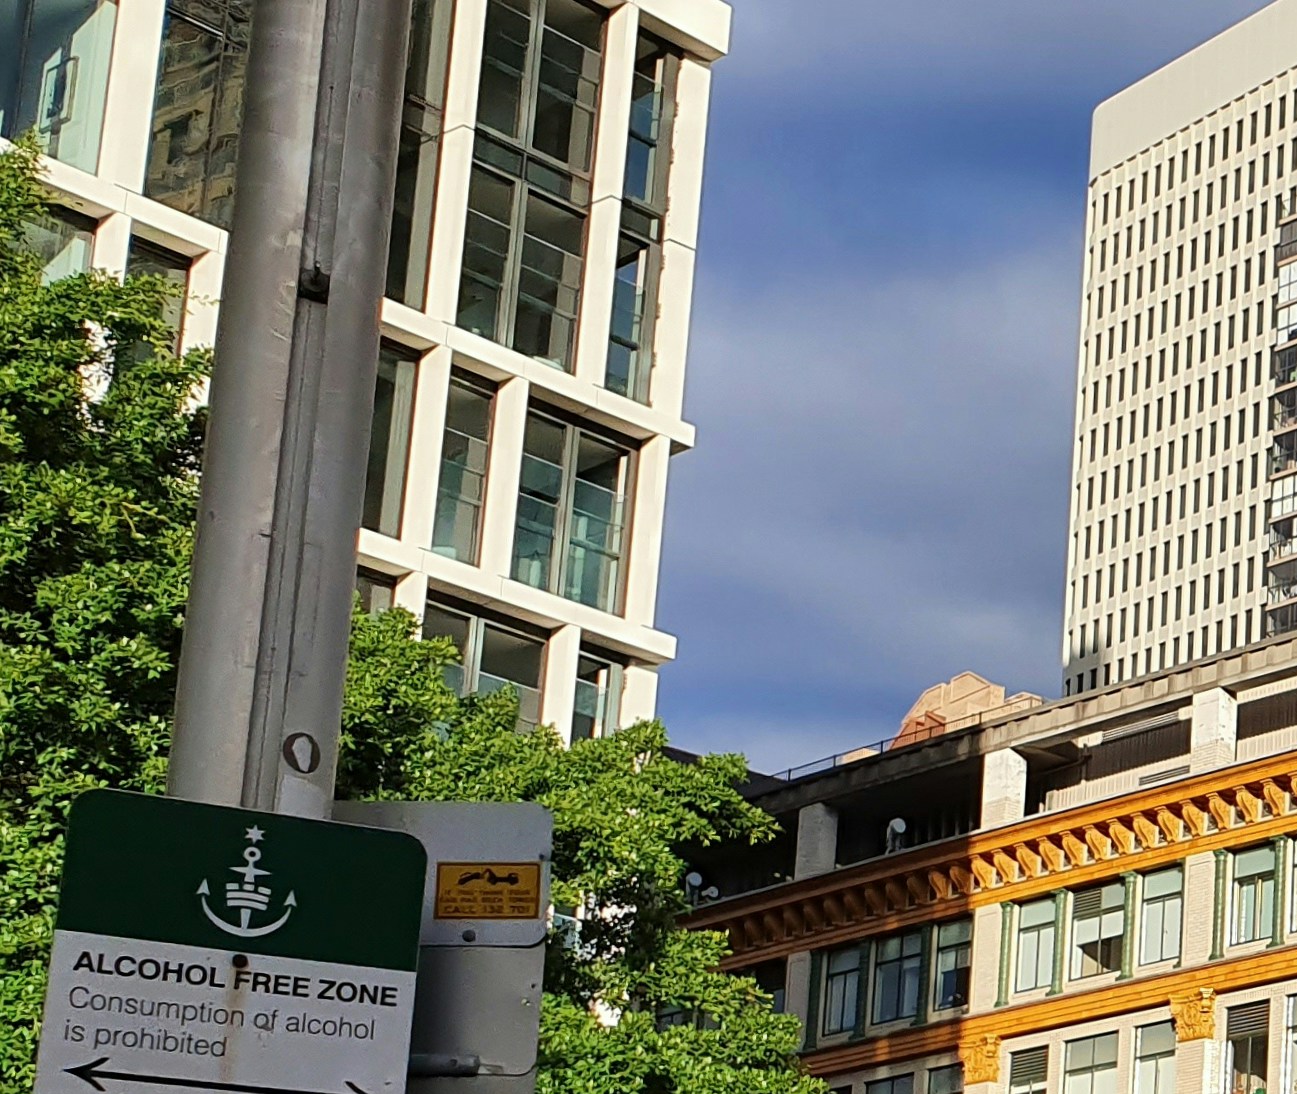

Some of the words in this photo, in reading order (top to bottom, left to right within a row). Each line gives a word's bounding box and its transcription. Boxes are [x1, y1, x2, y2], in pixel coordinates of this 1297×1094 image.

[73, 951, 225, 988] ALCOHOL
[233, 971, 311, 998] FREE
[317, 979, 399, 1007] ZONE
[63, 1019, 86, 1042] is
[94, 1023, 228, 1058] prohibited
[68, 986, 244, 1027] Consumption
[253, 1008, 277, 1032] of
[285, 1015, 376, 1041] alcohol
